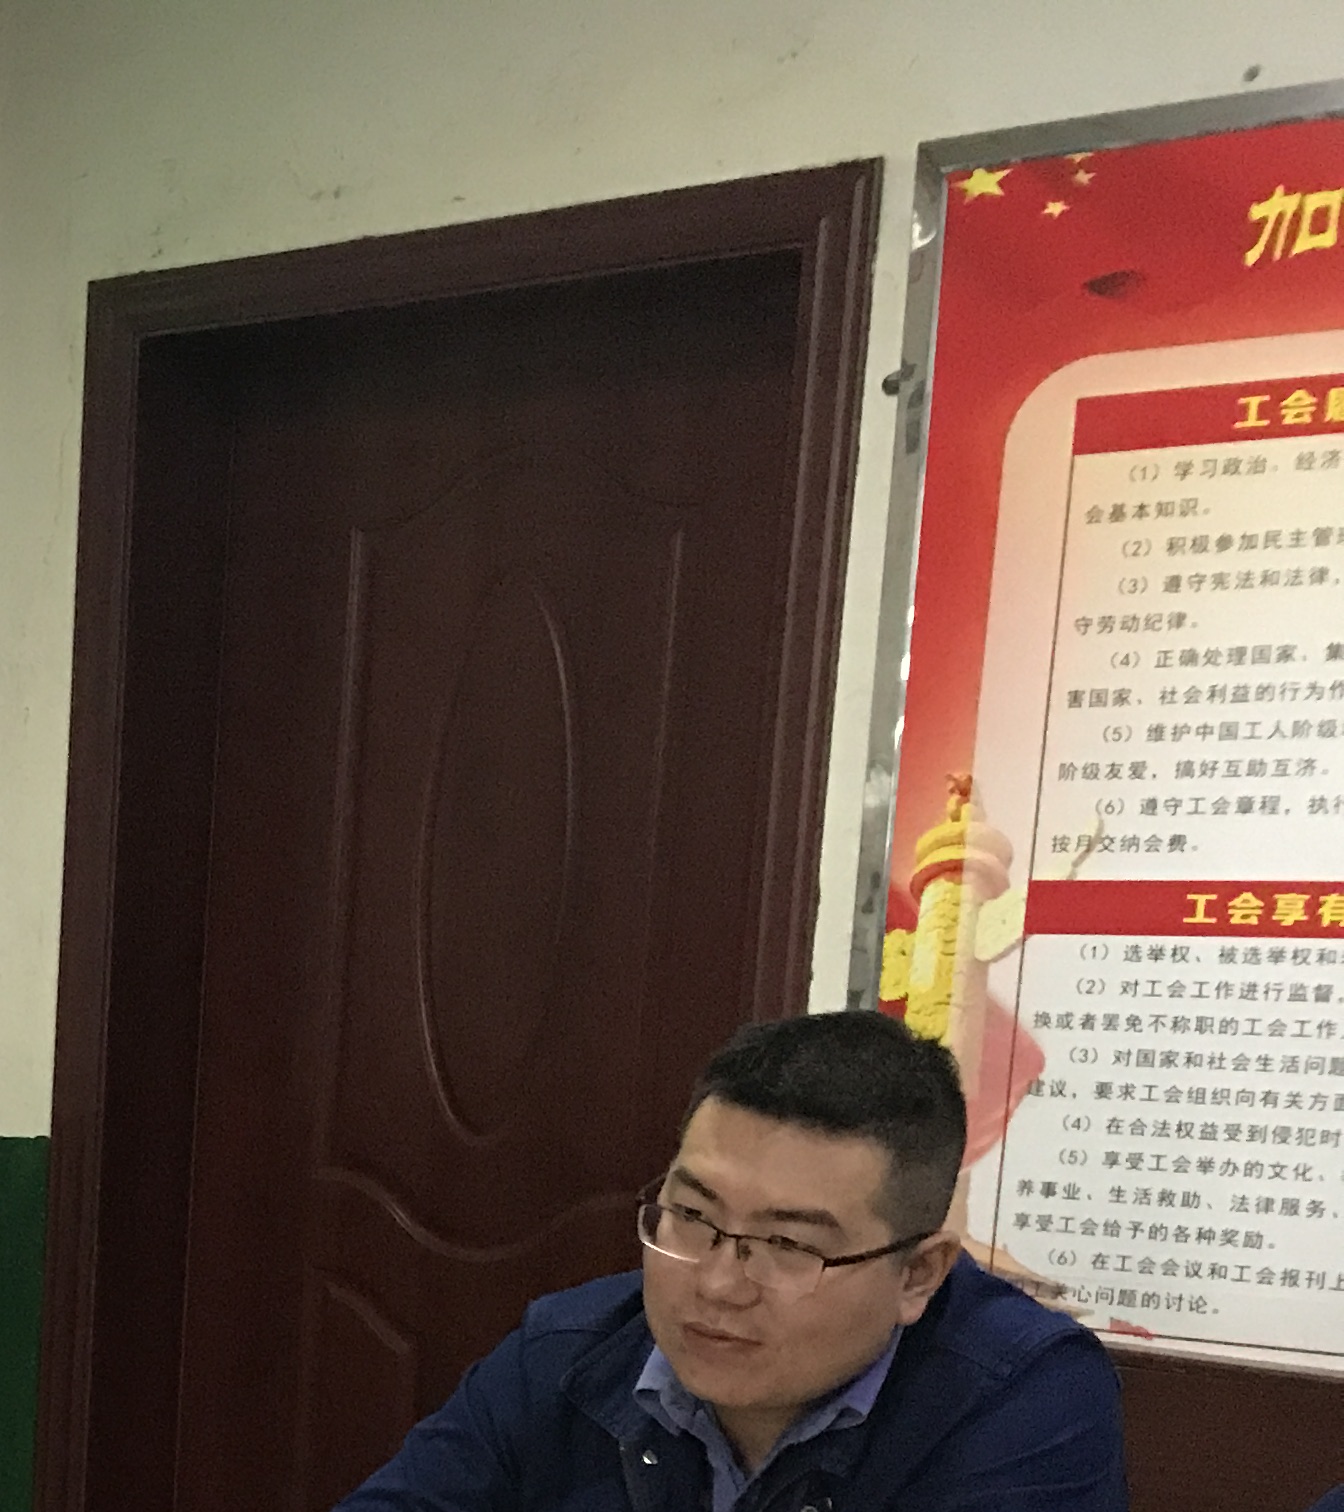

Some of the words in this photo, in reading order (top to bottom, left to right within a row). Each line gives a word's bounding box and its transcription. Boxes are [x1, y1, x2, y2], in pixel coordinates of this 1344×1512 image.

[1245, 185, 1344, 266] 加
[1102, 718, 1344, 744] （5）维护中国工人阶级
[1182, 891, 1344, 928] 工会享有
[1079, 942, 1344, 967] （1）选举权、被选举权和
[1032, 1009, 1344, 1040] 换或者罢免不称职的工会工作
[1058, 1147, 1344, 1183] （5）享受工会举办的文化、
